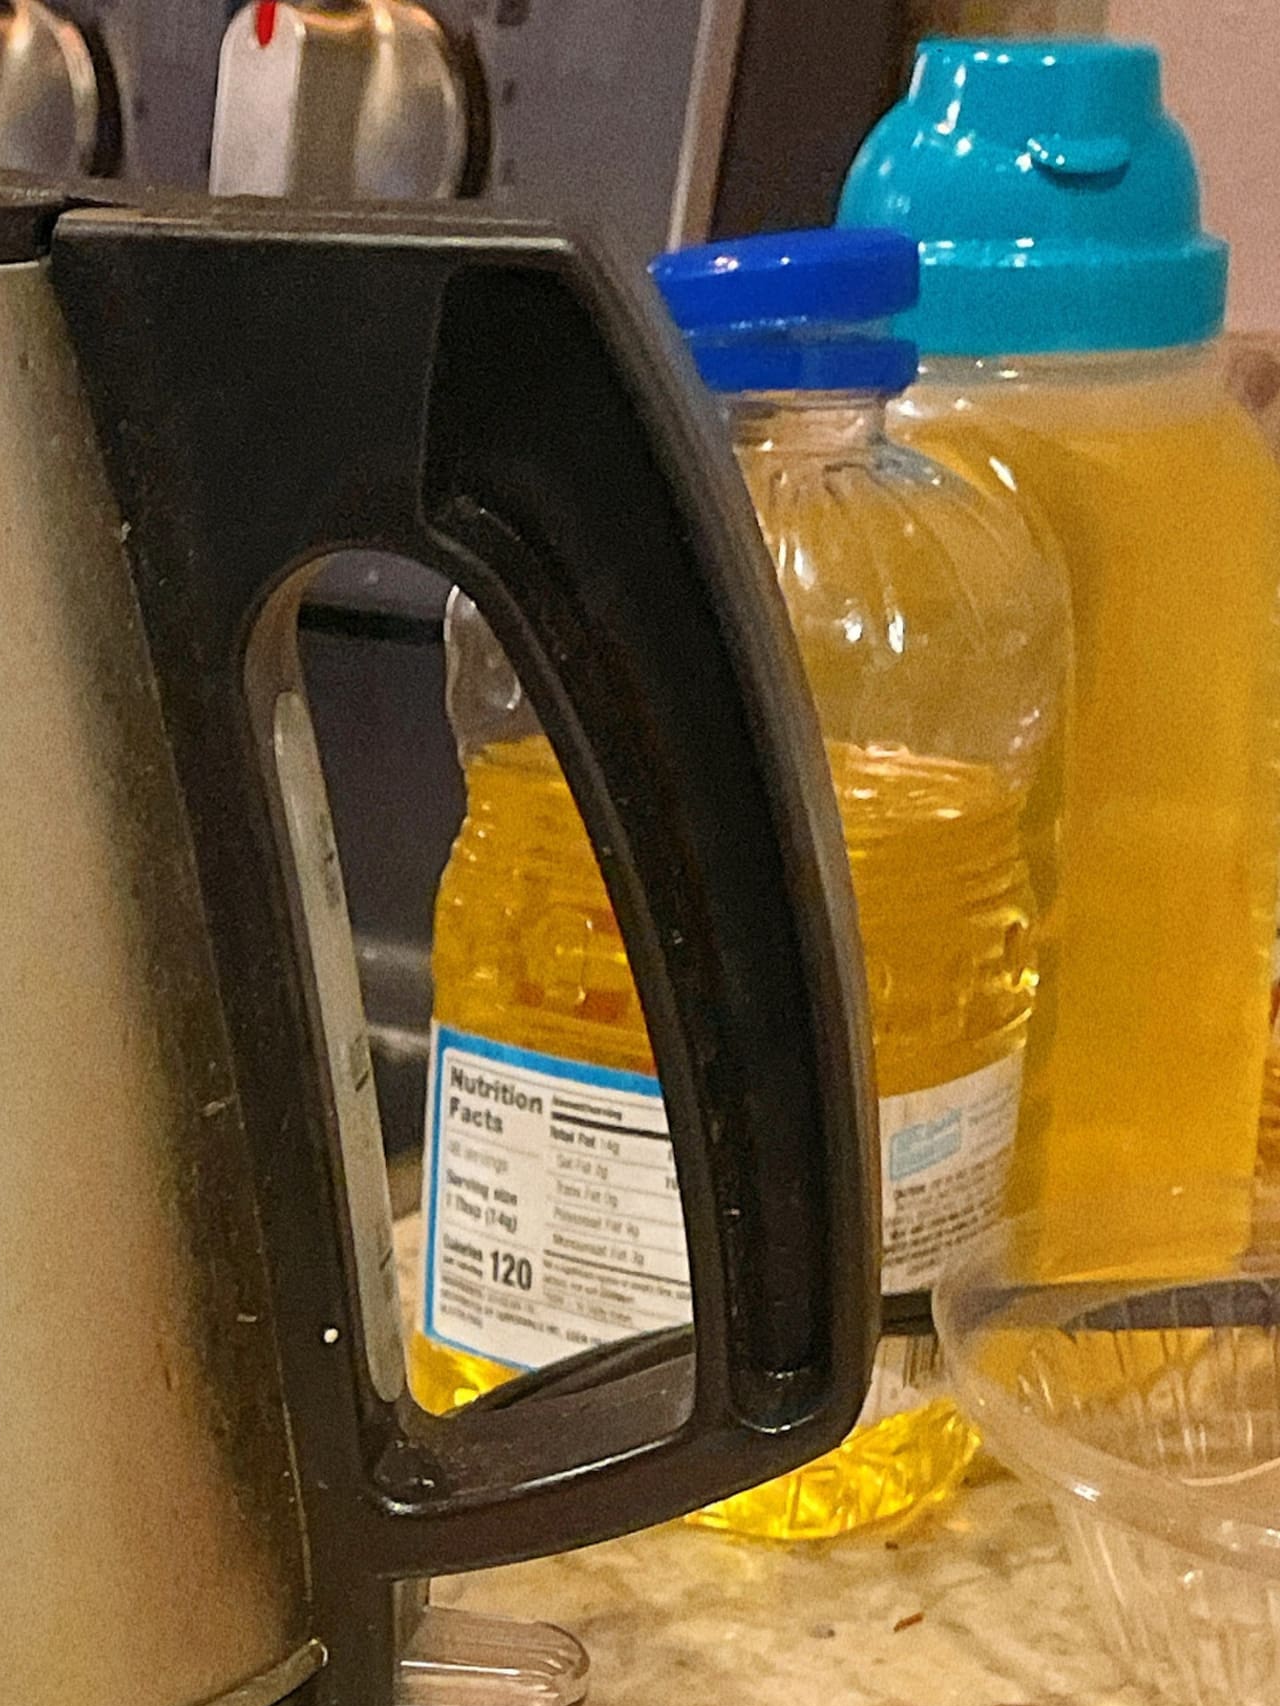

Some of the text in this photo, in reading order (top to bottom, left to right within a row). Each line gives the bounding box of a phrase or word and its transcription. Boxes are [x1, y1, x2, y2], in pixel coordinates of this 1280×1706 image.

[449, 1065, 544, 1115] Nutrition
[448, 1095, 505, 1134] Facts
[489, 1249, 533, 1291] 120
